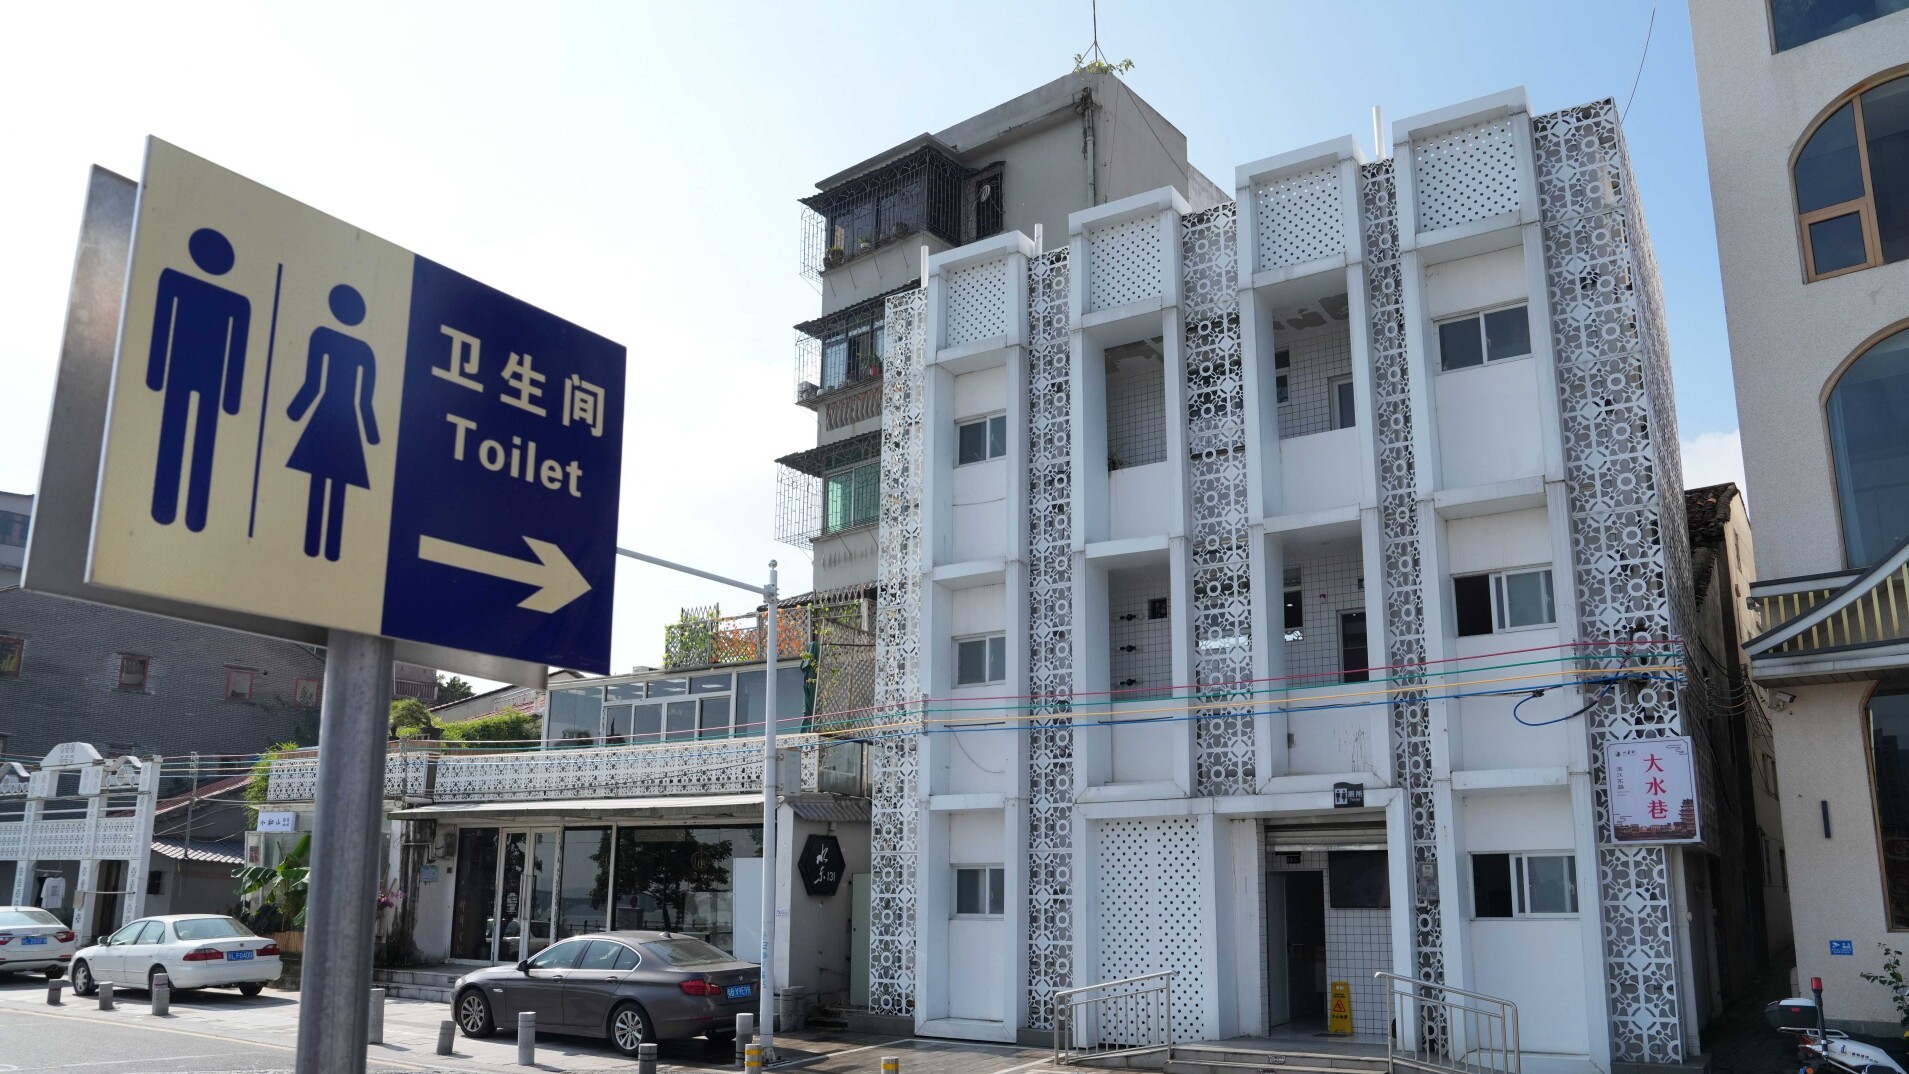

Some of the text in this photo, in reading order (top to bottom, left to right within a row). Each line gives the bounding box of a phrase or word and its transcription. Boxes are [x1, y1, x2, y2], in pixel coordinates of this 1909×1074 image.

[431, 324, 605, 438] 卫生间
[446, 412, 583, 498] Toilet
[1348, 790, 1363, 798] 厕所
[1643, 753, 1668, 819] 大水巷
[827, 871, 836, 882] 131
